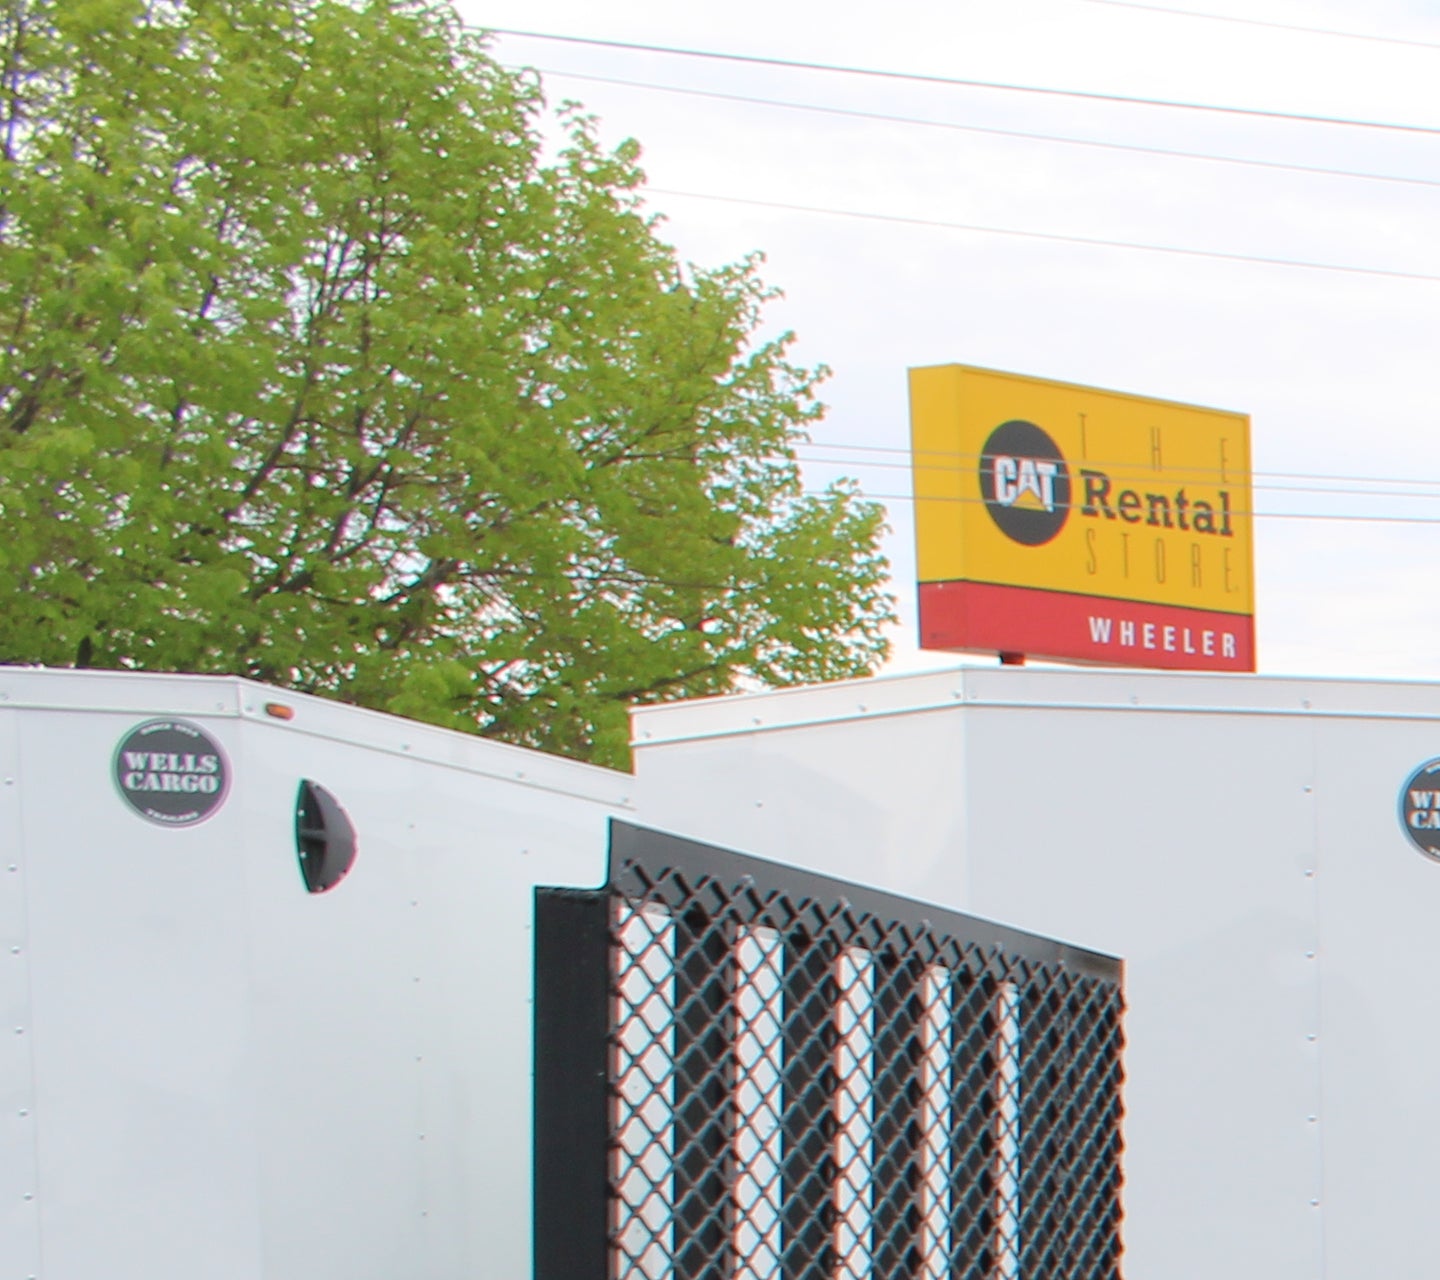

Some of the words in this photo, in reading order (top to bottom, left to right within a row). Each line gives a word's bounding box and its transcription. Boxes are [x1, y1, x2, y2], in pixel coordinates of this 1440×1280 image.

[1079, 412, 1230, 484] THE
[992, 455, 1058, 513] CAT
[1080, 469, 1234, 538] Rental
[1085, 528, 1232, 594] STORE
[1089, 616, 1237, 659] WHEELER
[123, 751, 219, 774] WELLS
[123, 771, 219, 794] CARGO
